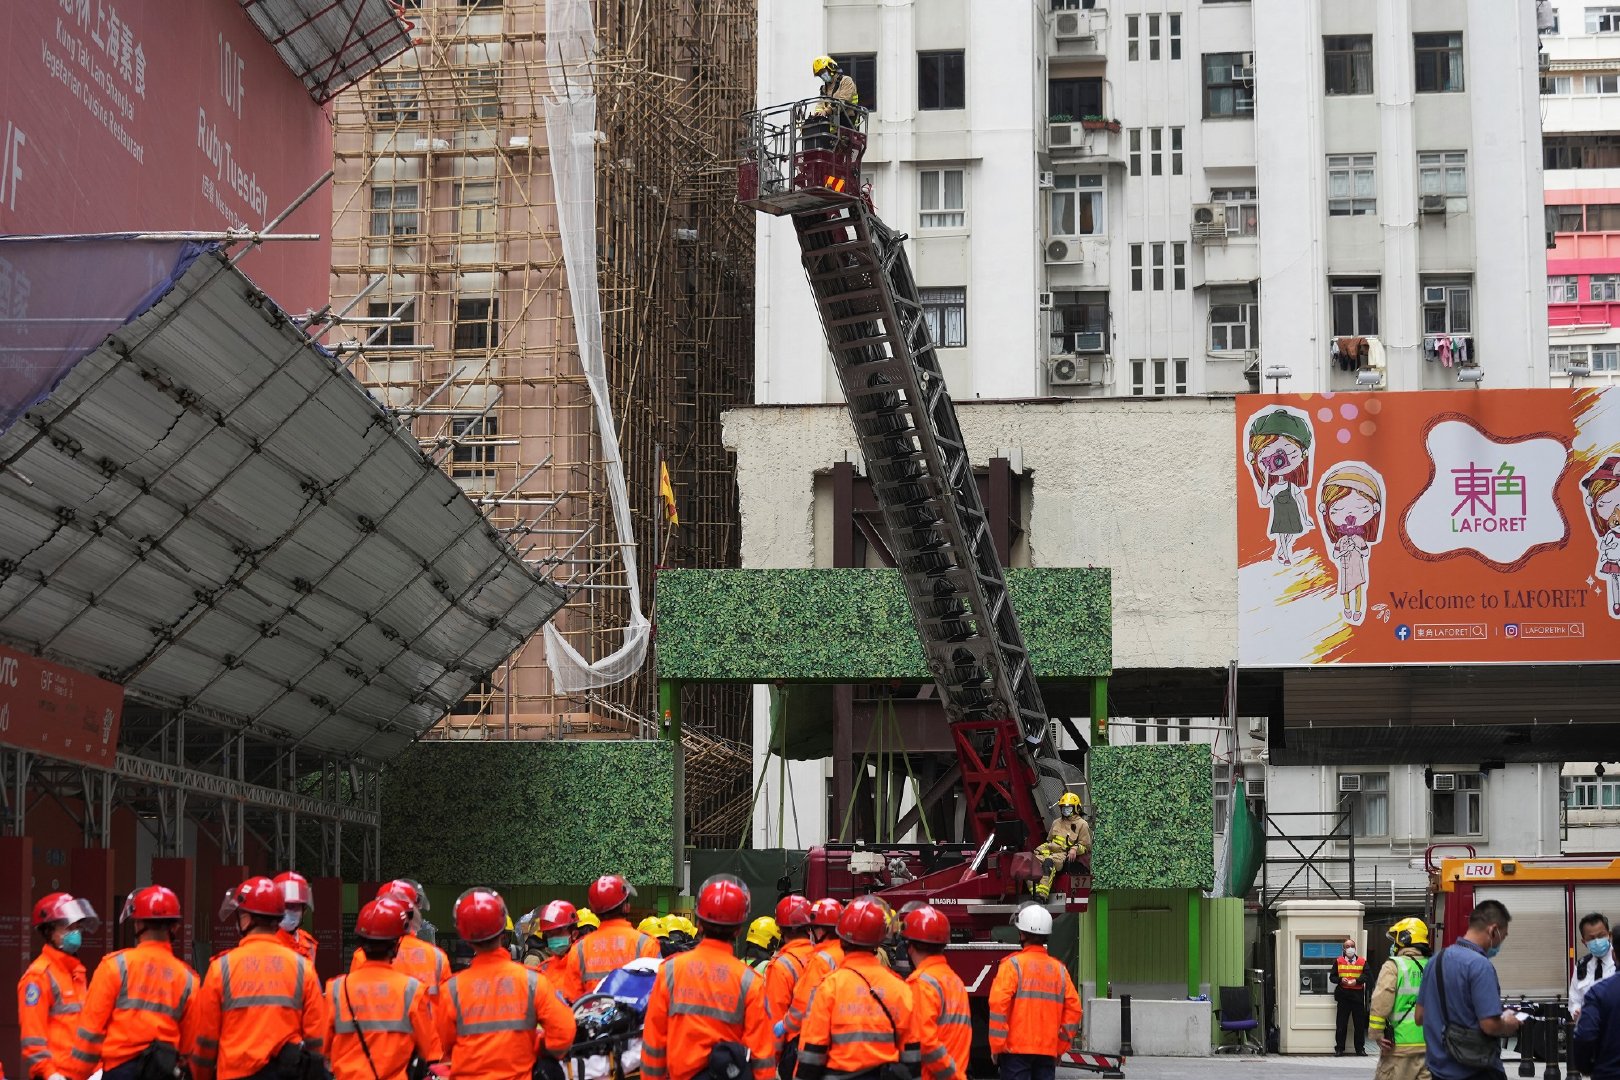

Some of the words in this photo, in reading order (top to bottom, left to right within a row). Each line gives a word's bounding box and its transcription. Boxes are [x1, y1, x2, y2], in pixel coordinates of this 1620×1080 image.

[56, 17, 75, 61] Kung
[77, 38, 90, 73] Tak
[106, 72, 135, 122] Shanghai
[218, 31, 245, 120] 10/F
[42, 37, 81, 98] Vegetarian
[83, 83, 108, 127] Cuisine
[108, 110, 144, 166] Restaurant
[197, 106, 223, 181] Ruby
[225, 141, 268, 229] Tuesday
[1451, 461, 1527, 517] 東角
[1451, 517, 1527, 533] LAFORET
[1389, 589, 1475, 610] Welcome
[1480, 592, 1499, 609] to
[1503, 589, 1588, 609] LAFORET
[1074, 878, 1087, 888] 37
[1466, 865, 1493, 876] LRU
